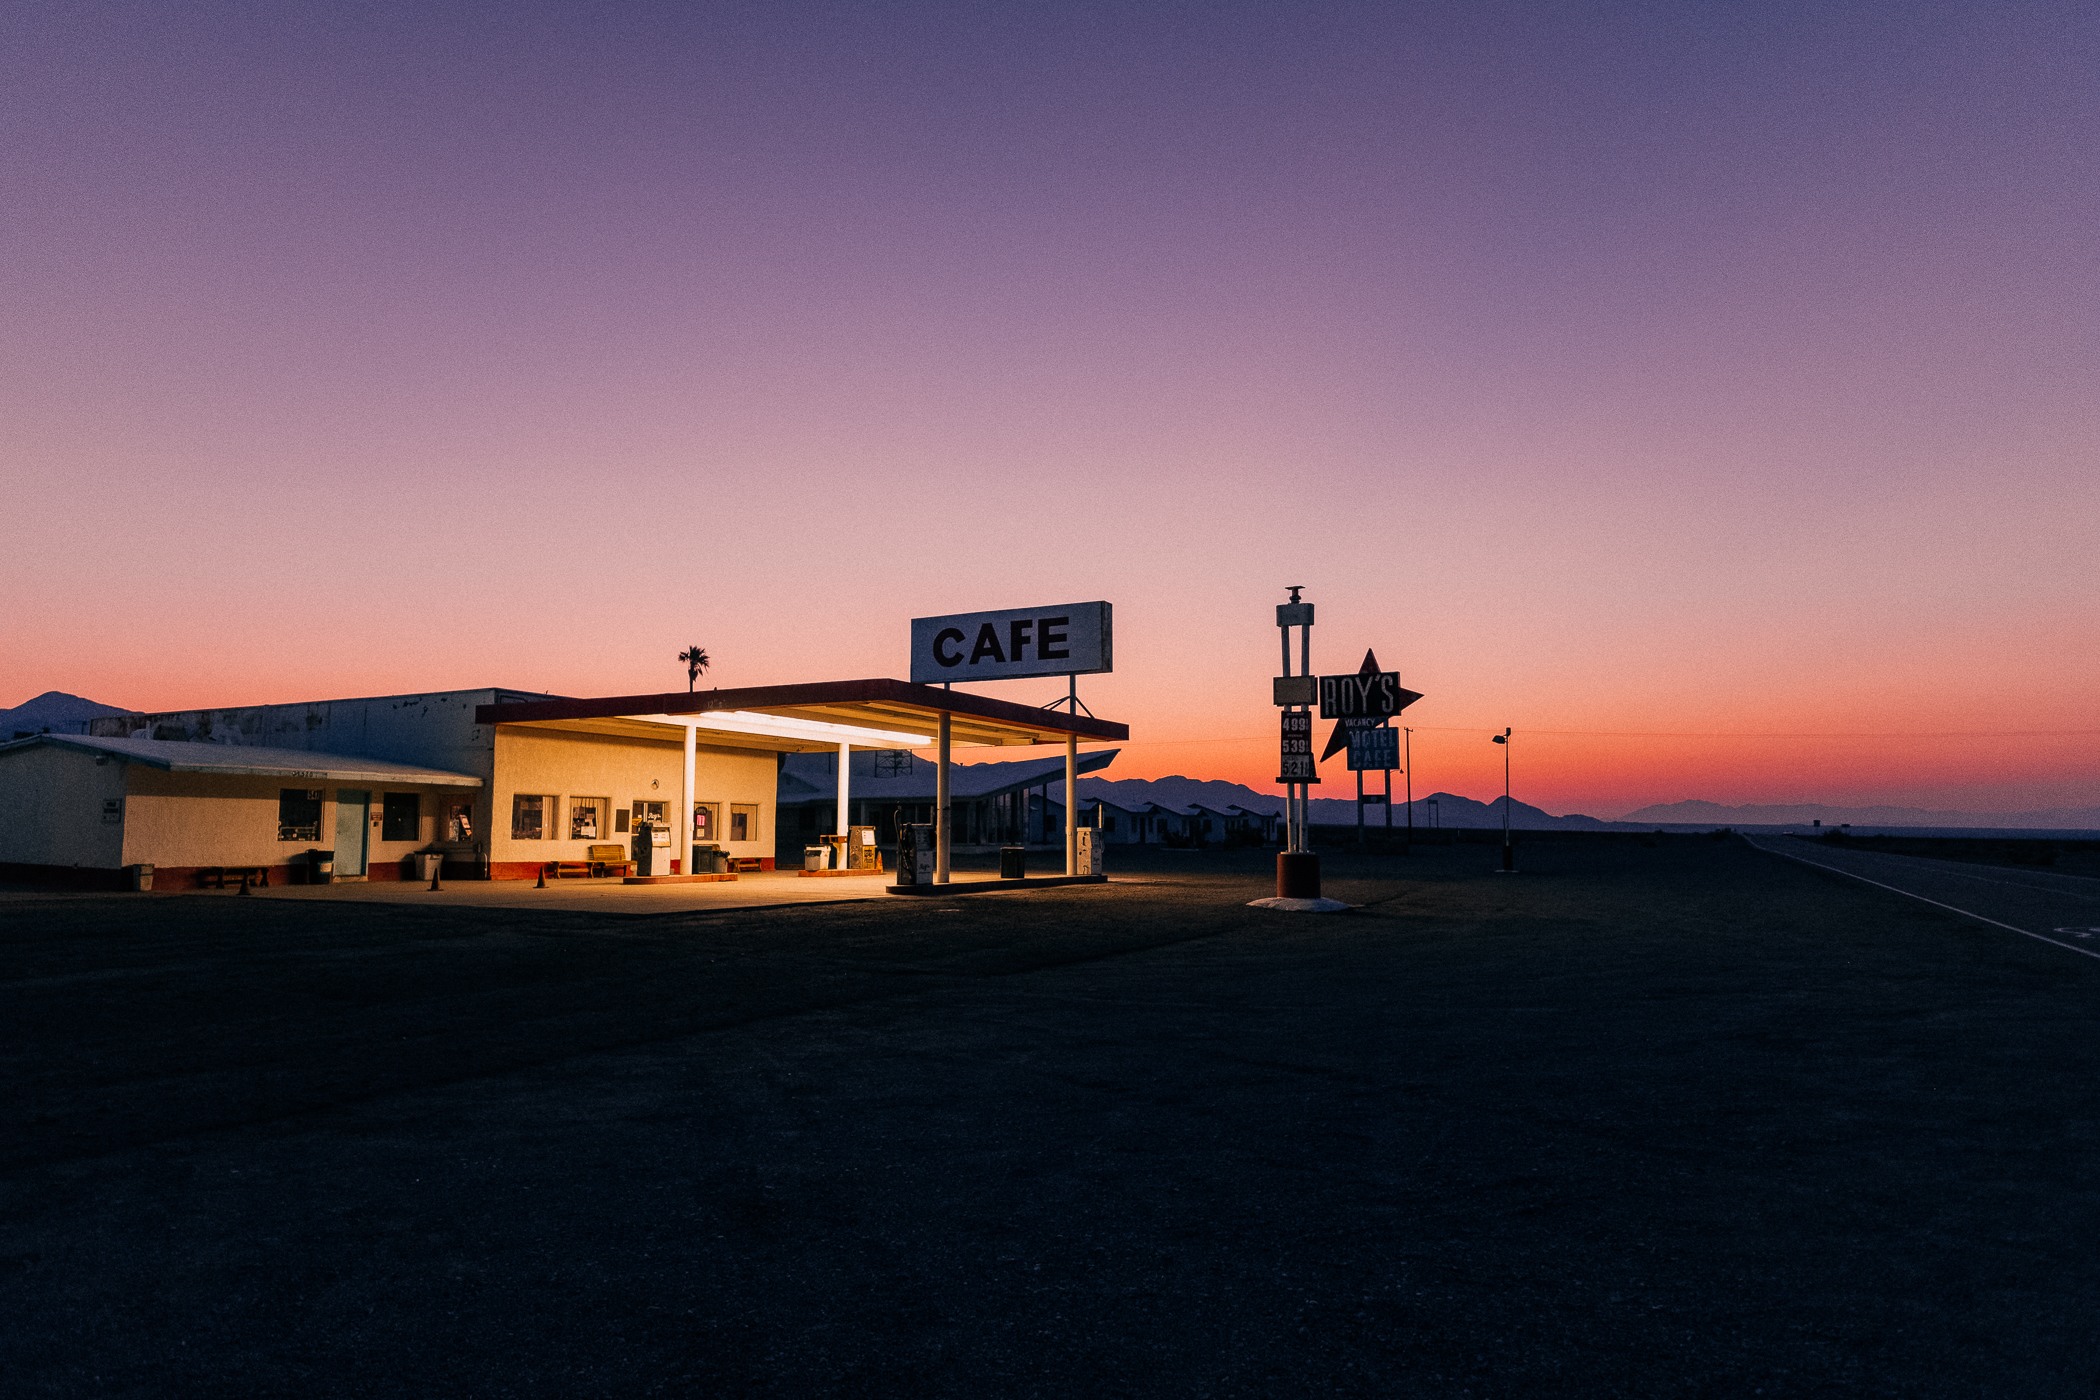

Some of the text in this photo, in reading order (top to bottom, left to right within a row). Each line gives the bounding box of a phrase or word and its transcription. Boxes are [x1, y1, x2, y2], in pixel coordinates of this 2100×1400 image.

[933, 616, 1069, 667] CAFE
[1324, 674, 1394, 716] ROY'S
[1345, 718, 1376, 727] VACANCY
[1349, 730, 1395, 748] MOTEL
[1353, 749, 1393, 768] CAFE
